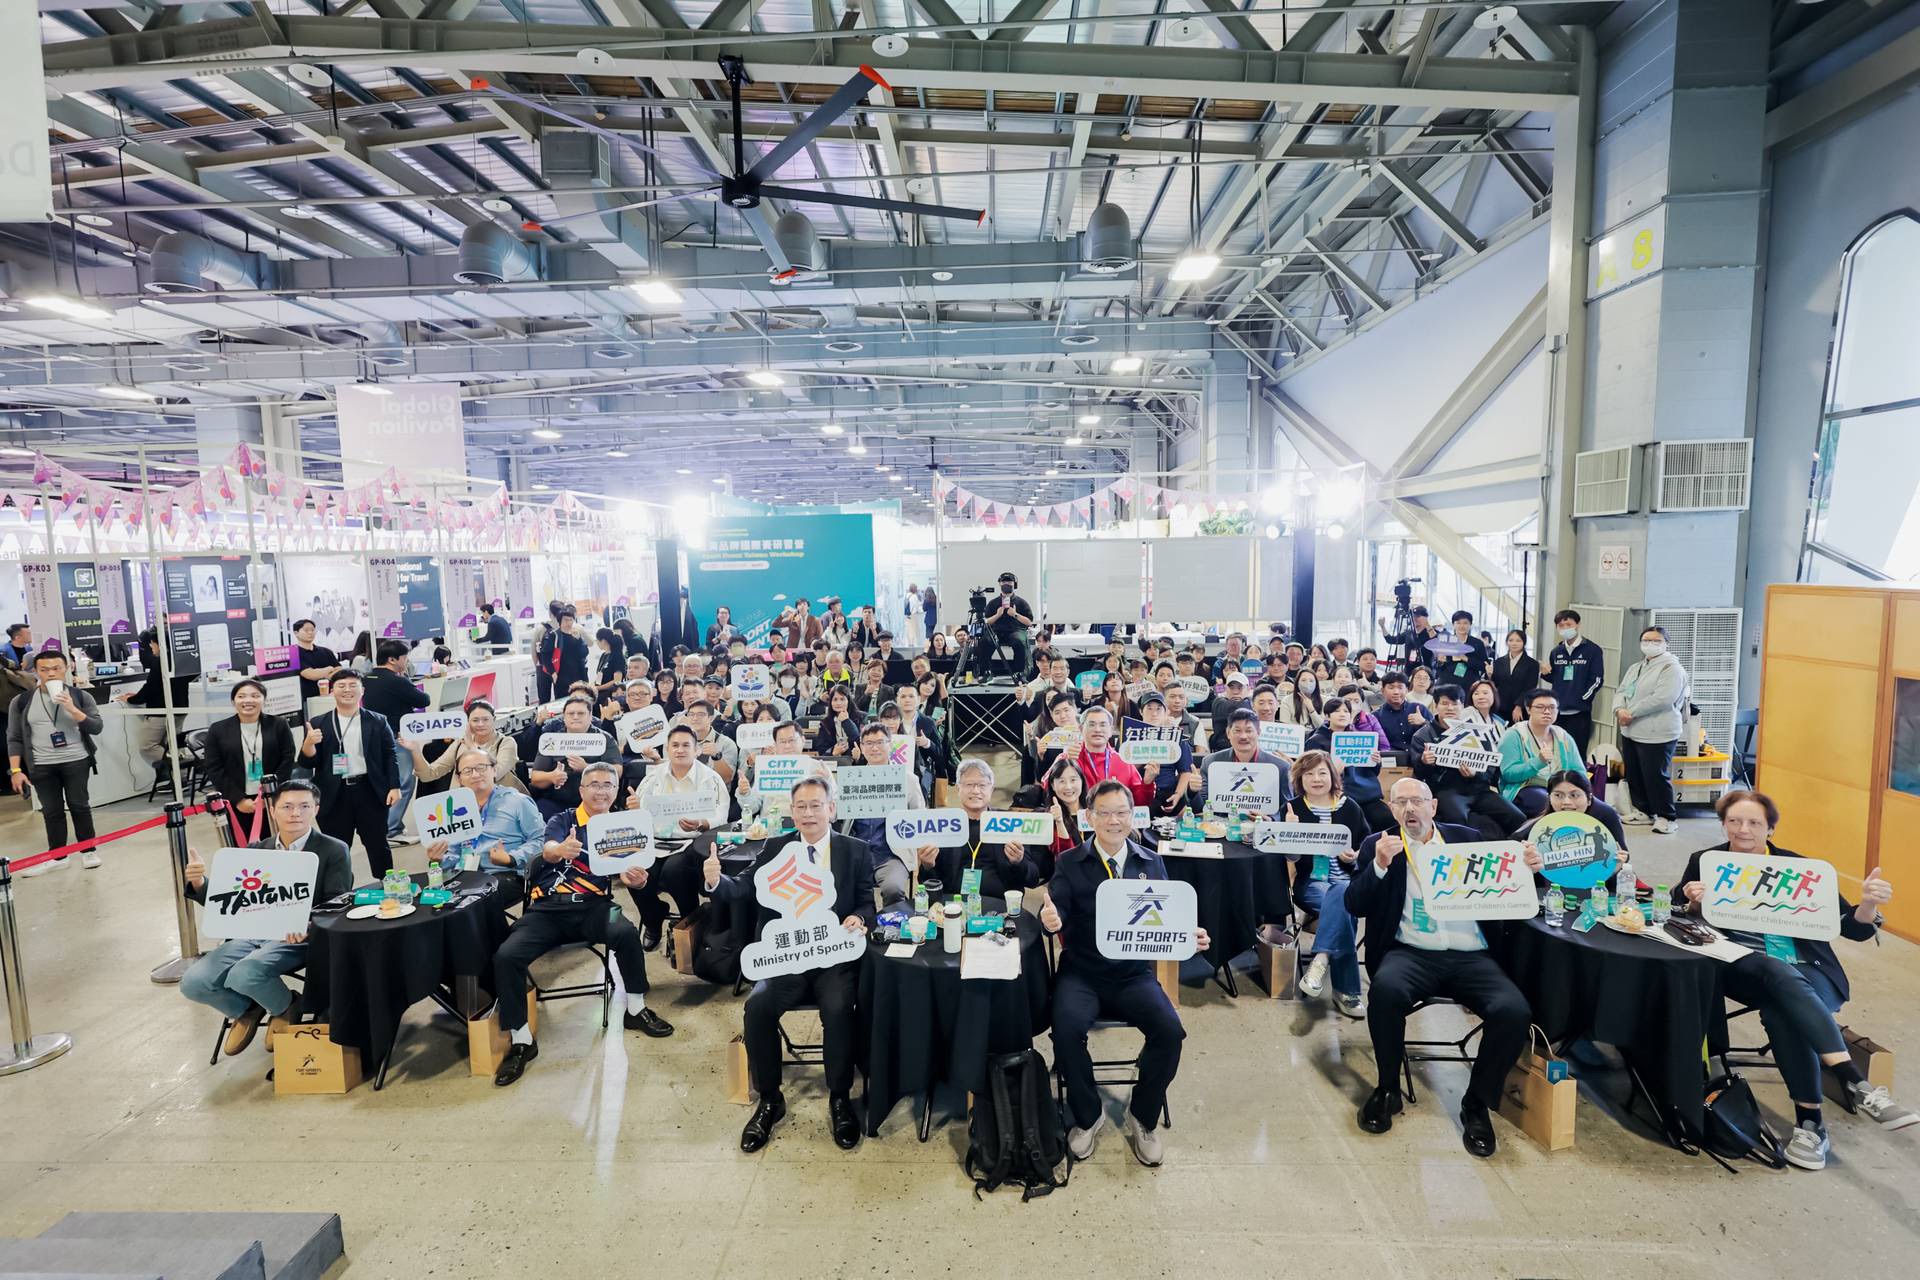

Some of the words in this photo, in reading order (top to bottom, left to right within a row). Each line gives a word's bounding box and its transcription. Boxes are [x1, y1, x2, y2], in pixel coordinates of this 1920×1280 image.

[1631, 228, 1654, 270] 8
[370, 558, 396, 566] GP-K04
[23, 564, 51, 573] GP-K03
[426, 718, 462, 729] IAPS
[1265, 725, 1294, 735] CITY
[1335, 748, 1372, 756] SPORTS
[1428, 745, 1451, 757] FUN
[1452, 750, 1499, 764] SPORTS
[767, 759, 798, 768] CITY
[1340, 756, 1369, 764] TECH
[1677, 769, 1683, 779] 2
[842, 783, 903, 795] 臺灣品牌國際賽
[1215, 794, 1234, 802] FUN
[1236, 795, 1272, 804] SPORTS
[1676, 792, 1682, 802] 2
[427, 819, 475, 838] TAIPEI
[917, 818, 962, 833] IAPS
[1547, 851, 1570, 862] HUA
[1574, 847, 1593, 857] HIN
[1557, 857, 1594, 868] MARATHON
[1432, 902, 1473, 911] International
[1473, 901, 1507, 910] Children's
[1508, 901, 1531, 909] Games
[1710, 911, 1760, 922] International
[1760, 915, 1800, 927] Children's
[1801, 921, 1832, 931] Games
[775, 925, 829, 950] 運動部
[1106, 930, 1133, 942] FUN
[1136, 931, 1188, 943] SPORTS
[1121, 943, 1131, 952] IN
[1134, 943, 1173, 953] TAIWAN
[752, 950, 801, 968] Ministry
[802, 947, 815, 958] of
[816, 940, 855, 956] Sports
